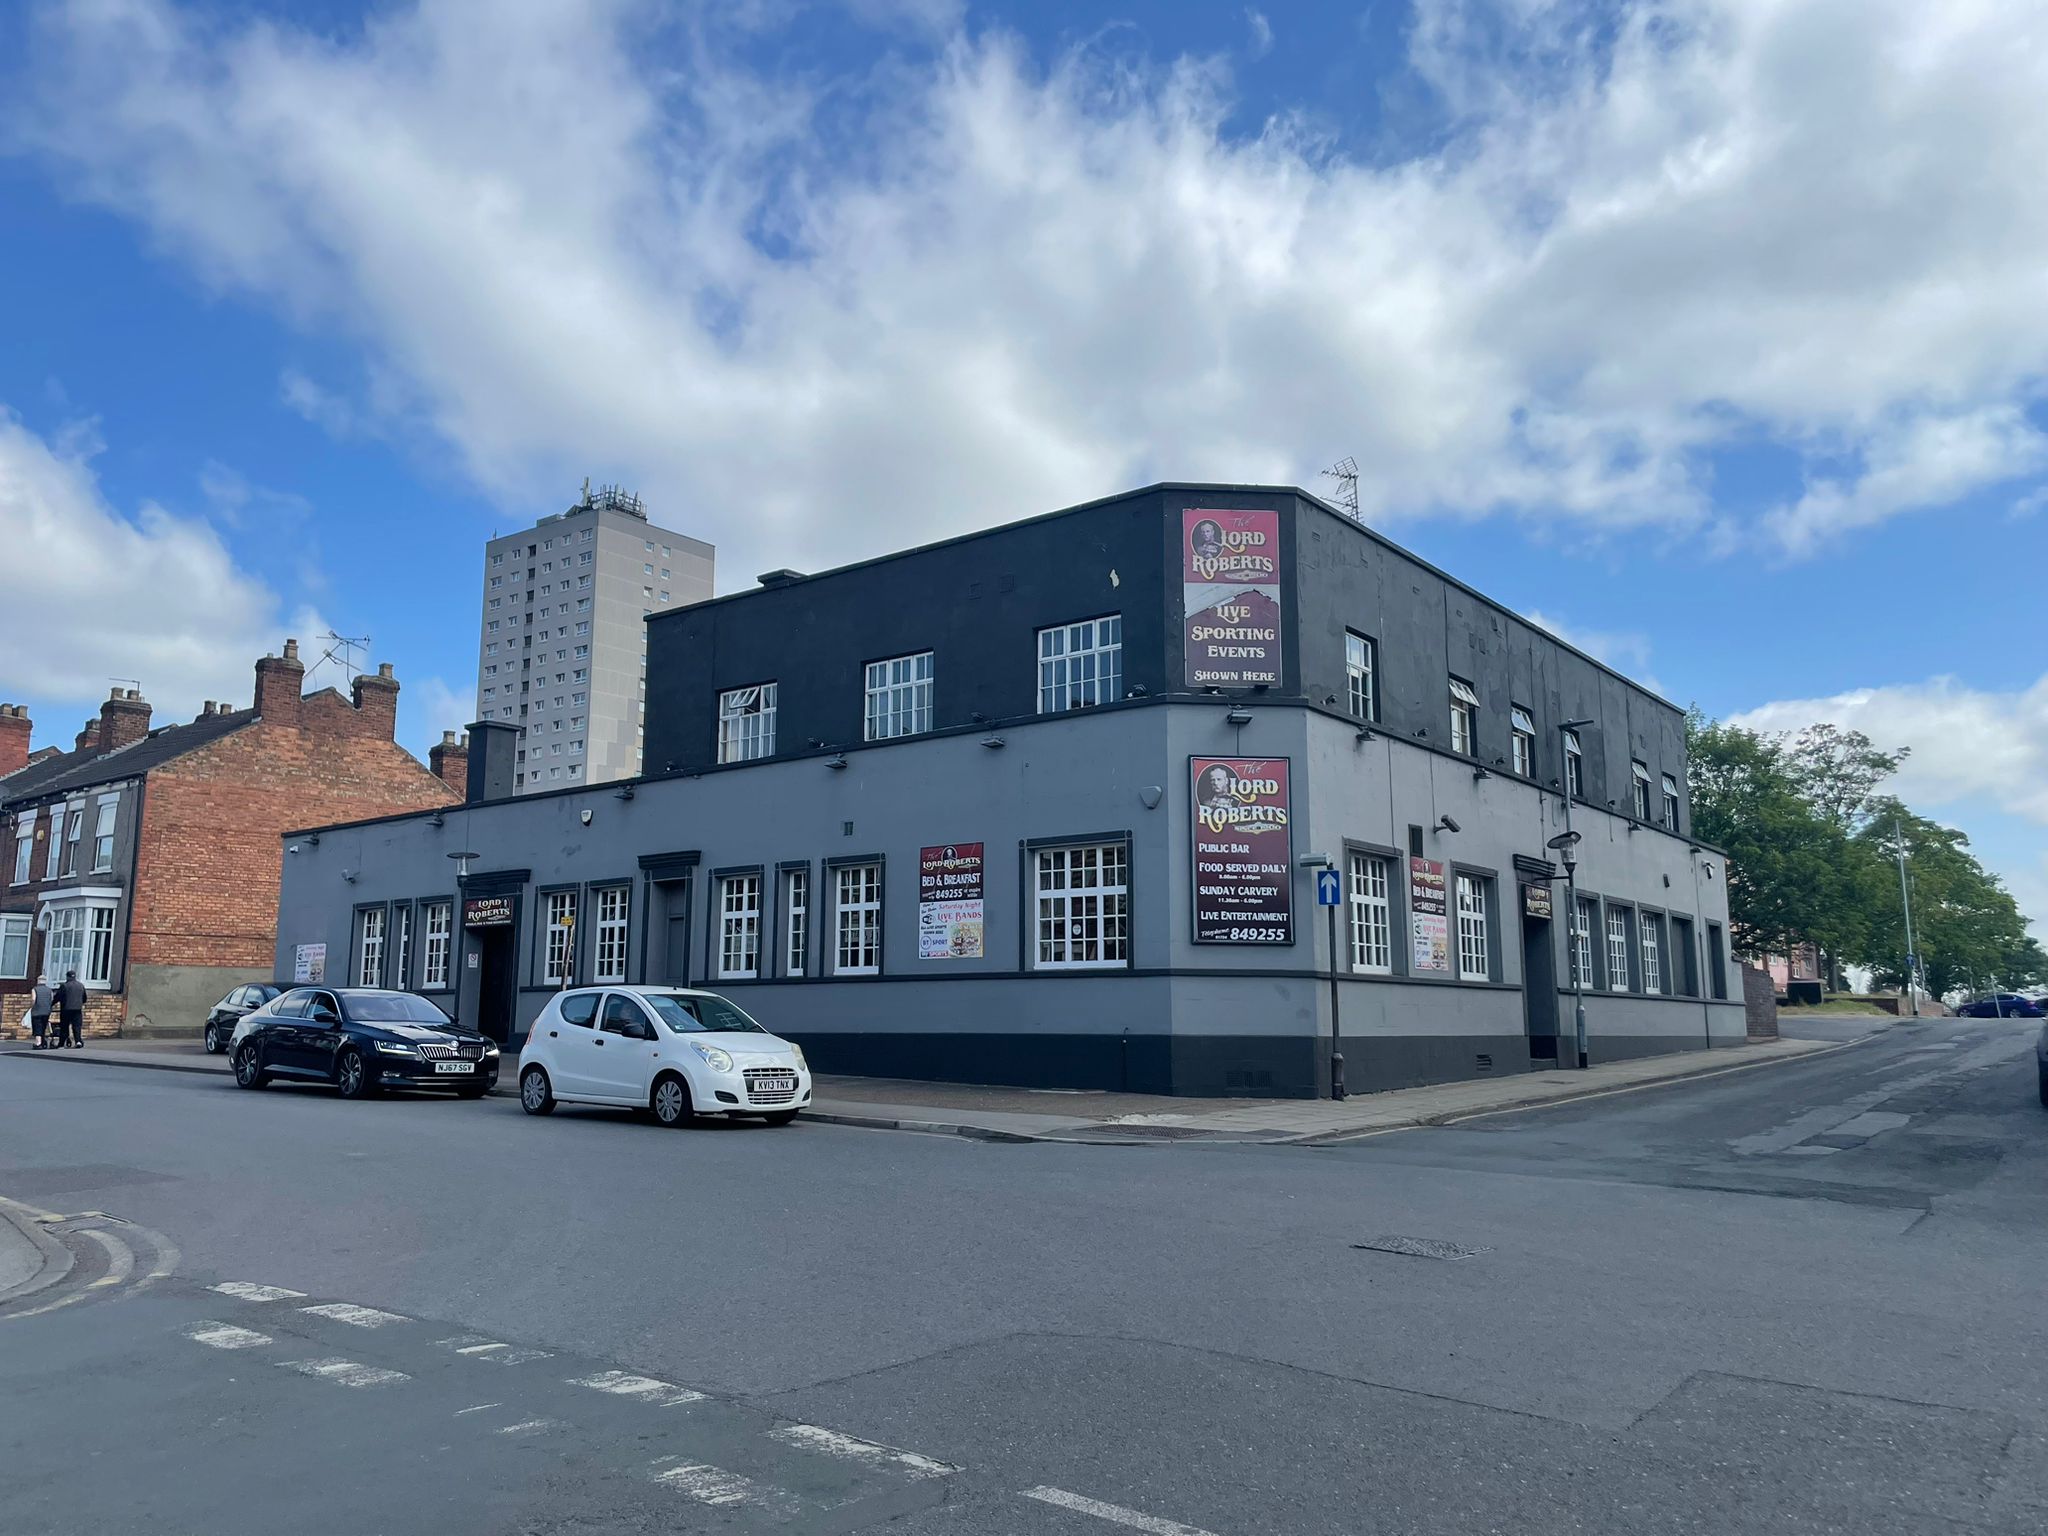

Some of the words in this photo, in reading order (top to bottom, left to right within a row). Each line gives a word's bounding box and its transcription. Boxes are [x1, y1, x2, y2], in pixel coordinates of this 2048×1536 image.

[1222, 530, 1265, 553] LORD
[1192, 554, 1273, 580] ROBERTS
[1217, 605, 1251, 624] LIVE
[1191, 626, 1275, 641] SPORTING
[1207, 645, 1266, 658] EVENTS
[1194, 670, 1239, 681] SHOWN
[1242, 671, 1275, 681] HERE
[1229, 777, 1279, 804] LORD
[1198, 805, 1288, 834] ROBERTS
[1198, 842, 1230, 853] PUBLIC
[1230, 843, 1250, 854] BAR
[923, 860, 943, 871] LORD
[1199, 862, 1224, 873] FOOD
[1225, 863, 1260, 873] SERVED
[1261, 864, 1287, 874] DAILY
[922, 875, 935, 887] BED
[936, 874, 943, 886] &
[943, 872, 981, 886] BREAKFAST
[935, 888, 963, 899] 849255
[1199, 885, 1236, 896] SUNDAY
[1237, 886, 1279, 897] CARVERY
[478, 899, 502, 910] LORD
[468, 908, 510, 921] ROBERTS
[955, 911, 982, 922] BANDS
[1200, 910, 1220, 921] LIVE
[1220, 910, 1289, 922] ENTERTAINMENT
[1229, 927, 1286, 942] 849255
[758, 1080, 775, 1090] KY13
[776, 1080, 790, 1090] TNX
